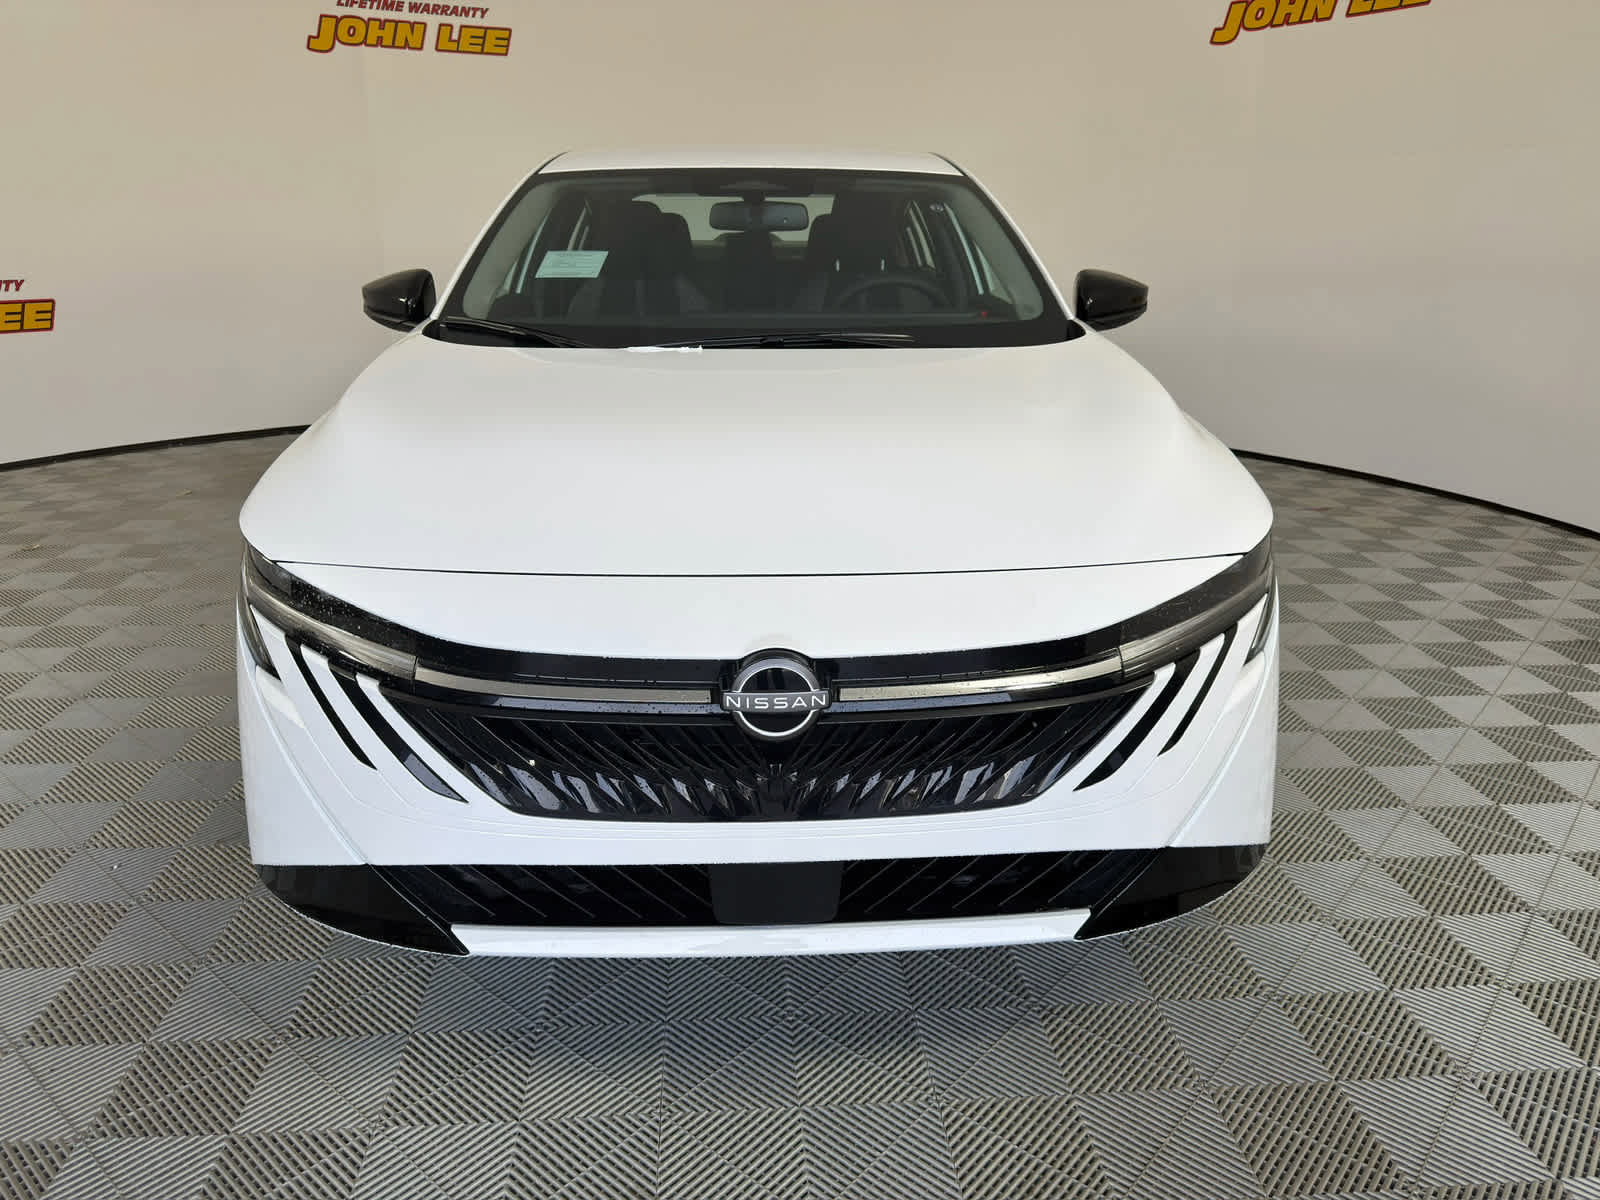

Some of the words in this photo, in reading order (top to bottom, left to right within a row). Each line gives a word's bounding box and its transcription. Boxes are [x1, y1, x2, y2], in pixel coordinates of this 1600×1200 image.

[336, 0, 404, 12] LIFETIME
[408, 1, 489, 19] WARRANTY
[1210, 0, 1337, 45] JOHN
[307, 14, 427, 53] JOHN
[435, 23, 512, 56] LEE
[0, 279, 24, 292] TY
[726, 694, 826, 709] NISSAN
